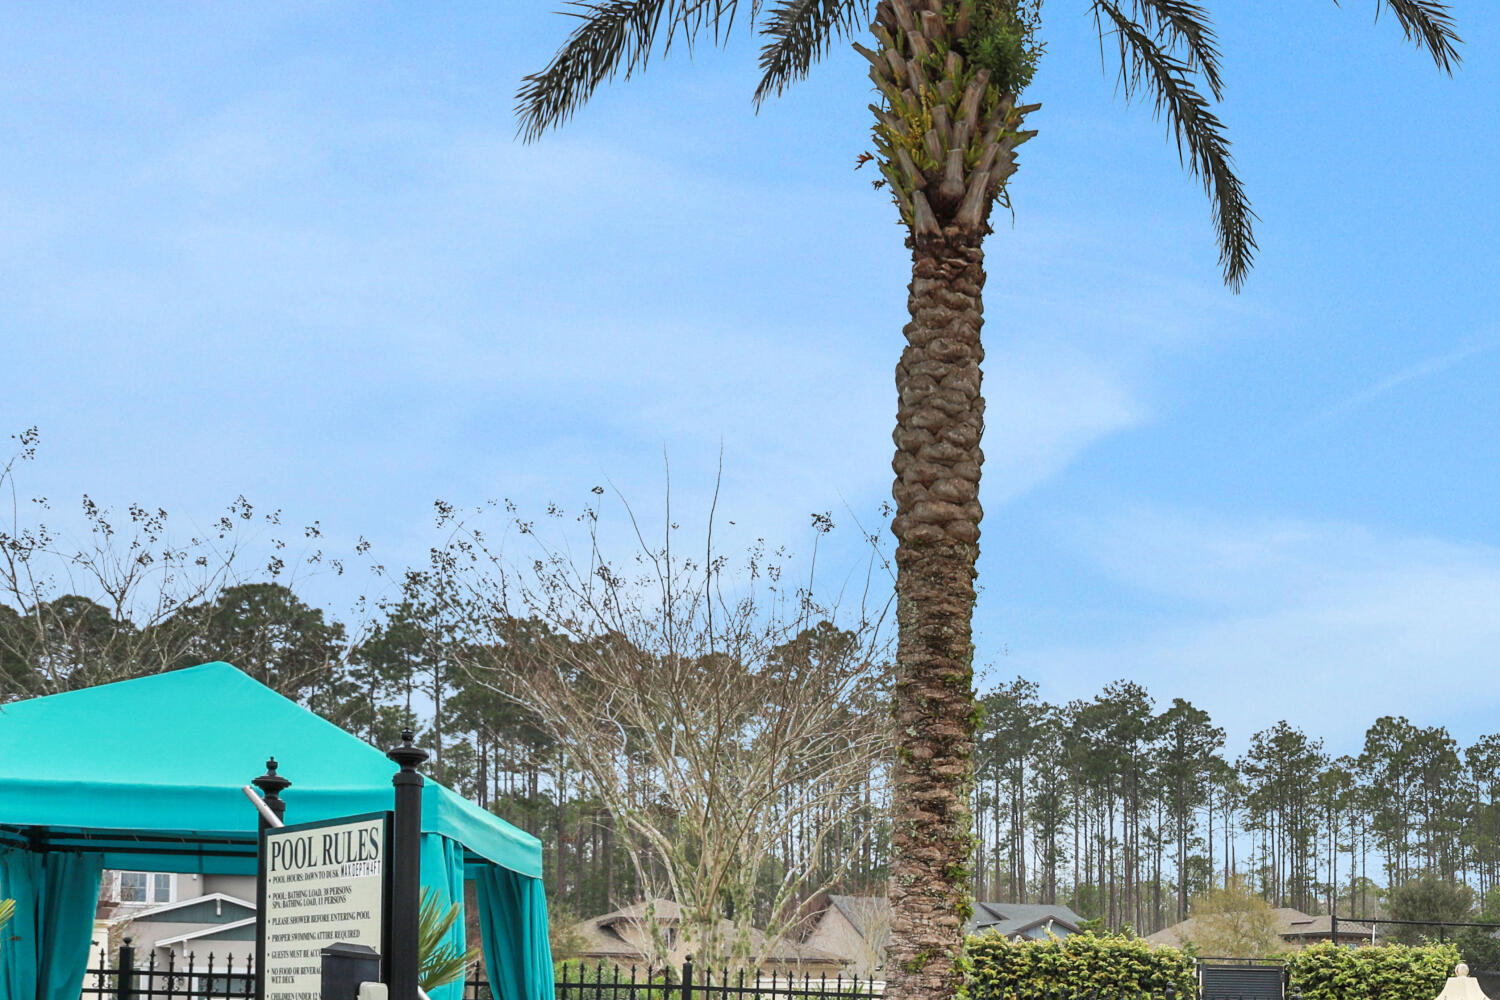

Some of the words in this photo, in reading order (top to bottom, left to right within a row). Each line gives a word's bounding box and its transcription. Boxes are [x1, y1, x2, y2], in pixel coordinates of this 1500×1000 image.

[271, 836, 318, 871] POOL
[322, 827, 378, 866] RULES
[273, 876, 286, 884] POOL
[305, 872, 318, 880] DAWN
[319, 871, 326, 880] TO
[326, 870, 339, 878] DUSK
[288, 890, 308, 899] BATHING
[330, 886, 352, 896] PERSONS
[283, 900, 302, 908] BATHING
[324, 896, 346, 904] PERSONS
[272, 917, 289, 926] PLEASE
[290, 916, 310, 924] SHOWER
[311, 914, 330, 923] BEFORE
[330, 912, 356, 922] ENTERING
[356, 910, 371, 920] POOL
[272, 934, 290, 942] PROPER
[291, 932, 316, 941] SWIMMING
[317, 931, 334, 940] ATTIRE
[334, 930, 360, 940] REQUIRED
[272, 951, 288, 959] GUESTS
[290, 950, 302, 958] MUST
[304, 950, 310, 958] BE
[293, 967, 300, 975] OR
[300, 966, 321, 975] BEVERA
[272, 976, 281, 984] WET
[282, 976, 295, 984] DECK
[271, 992, 294, 1000] CHILDREN
[296, 992, 312, 1000] UNDER
[312, 992, 318, 1000] 12
